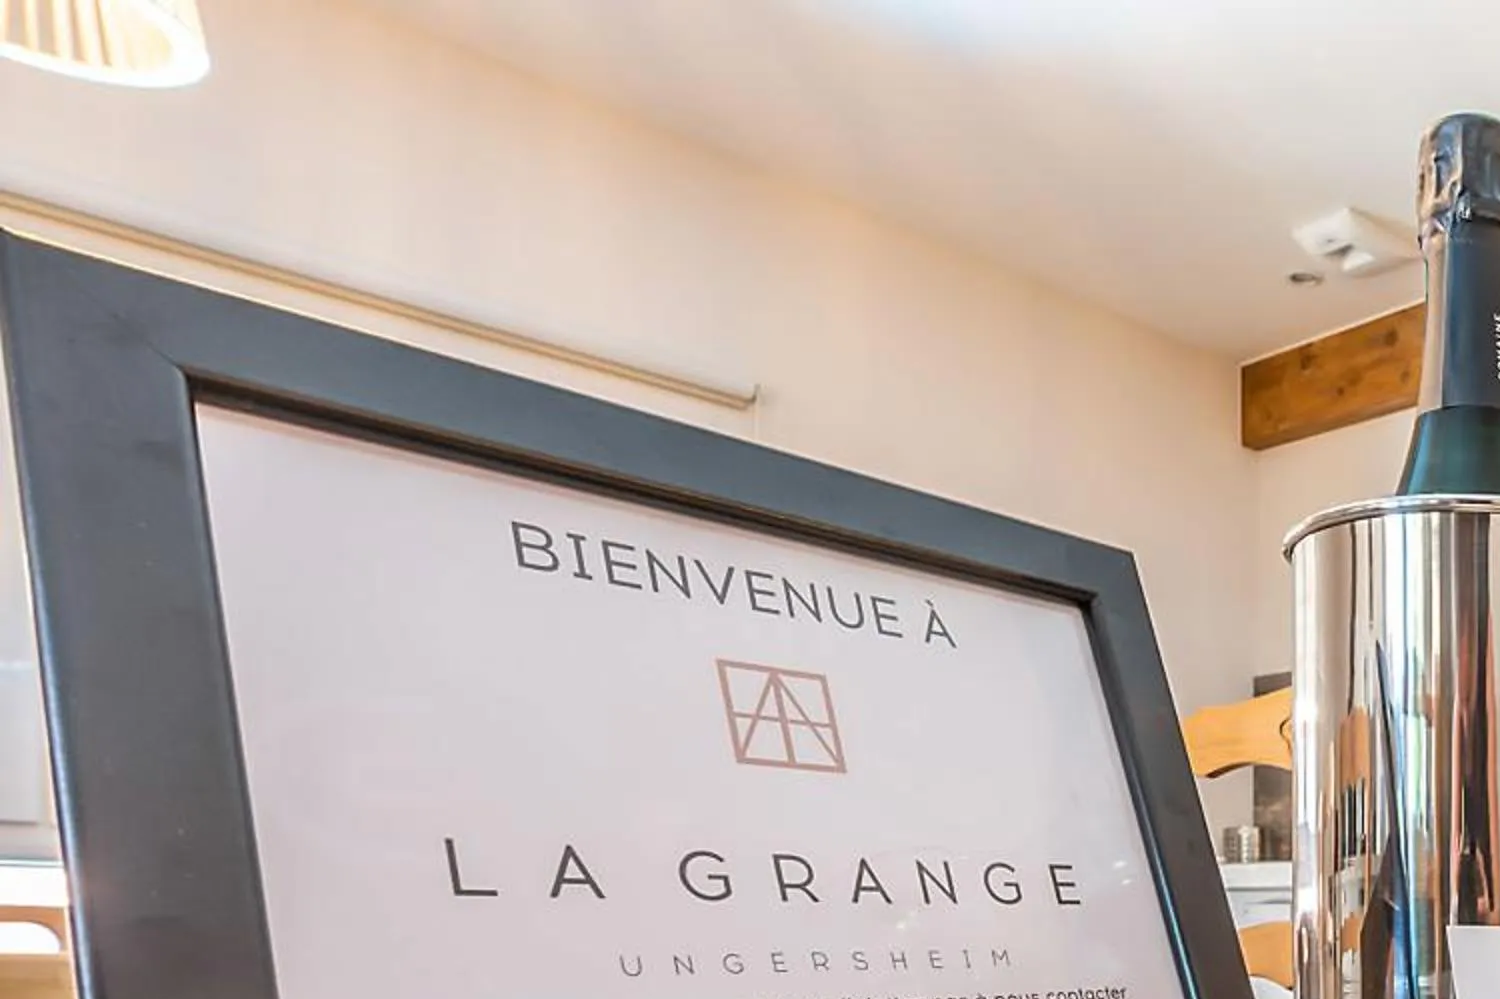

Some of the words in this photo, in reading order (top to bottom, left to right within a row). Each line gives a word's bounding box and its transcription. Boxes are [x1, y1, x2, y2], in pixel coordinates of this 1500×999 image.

[511, 520, 904, 638] BIENVENUE
[922, 599, 957, 649] À
[444, 837, 606, 900] LA
[678, 849, 1083, 906] GRANGE
[620, 949, 1012, 978] UNGERSHEIM
